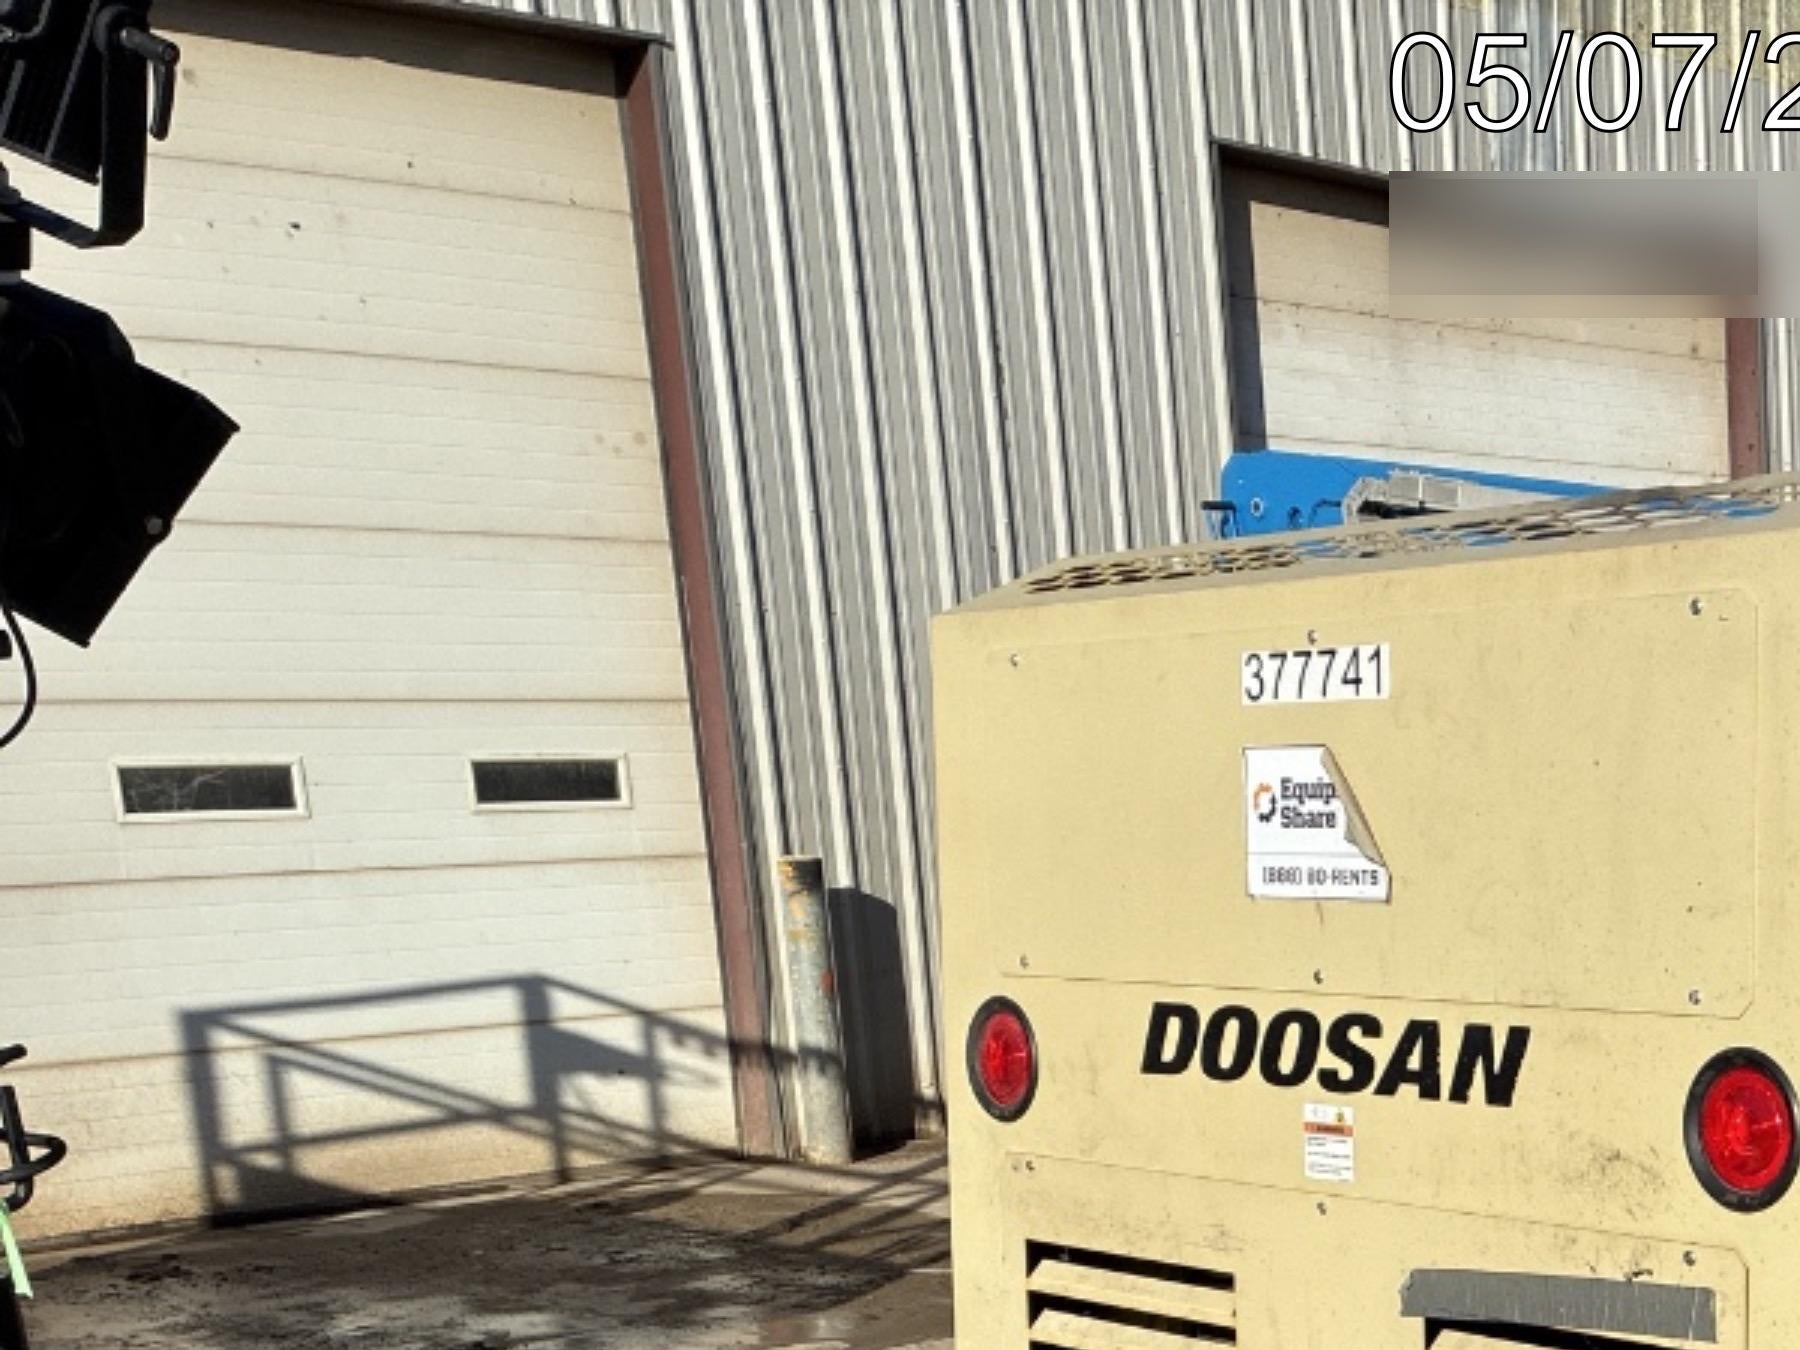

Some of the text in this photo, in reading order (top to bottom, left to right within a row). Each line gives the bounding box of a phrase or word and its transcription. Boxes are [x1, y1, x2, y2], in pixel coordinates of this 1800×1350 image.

[1243, 644, 1383, 703] 377741
[1280, 806, 1336, 829] Share
[1140, 1001, 1531, 1107] DOOSAN
